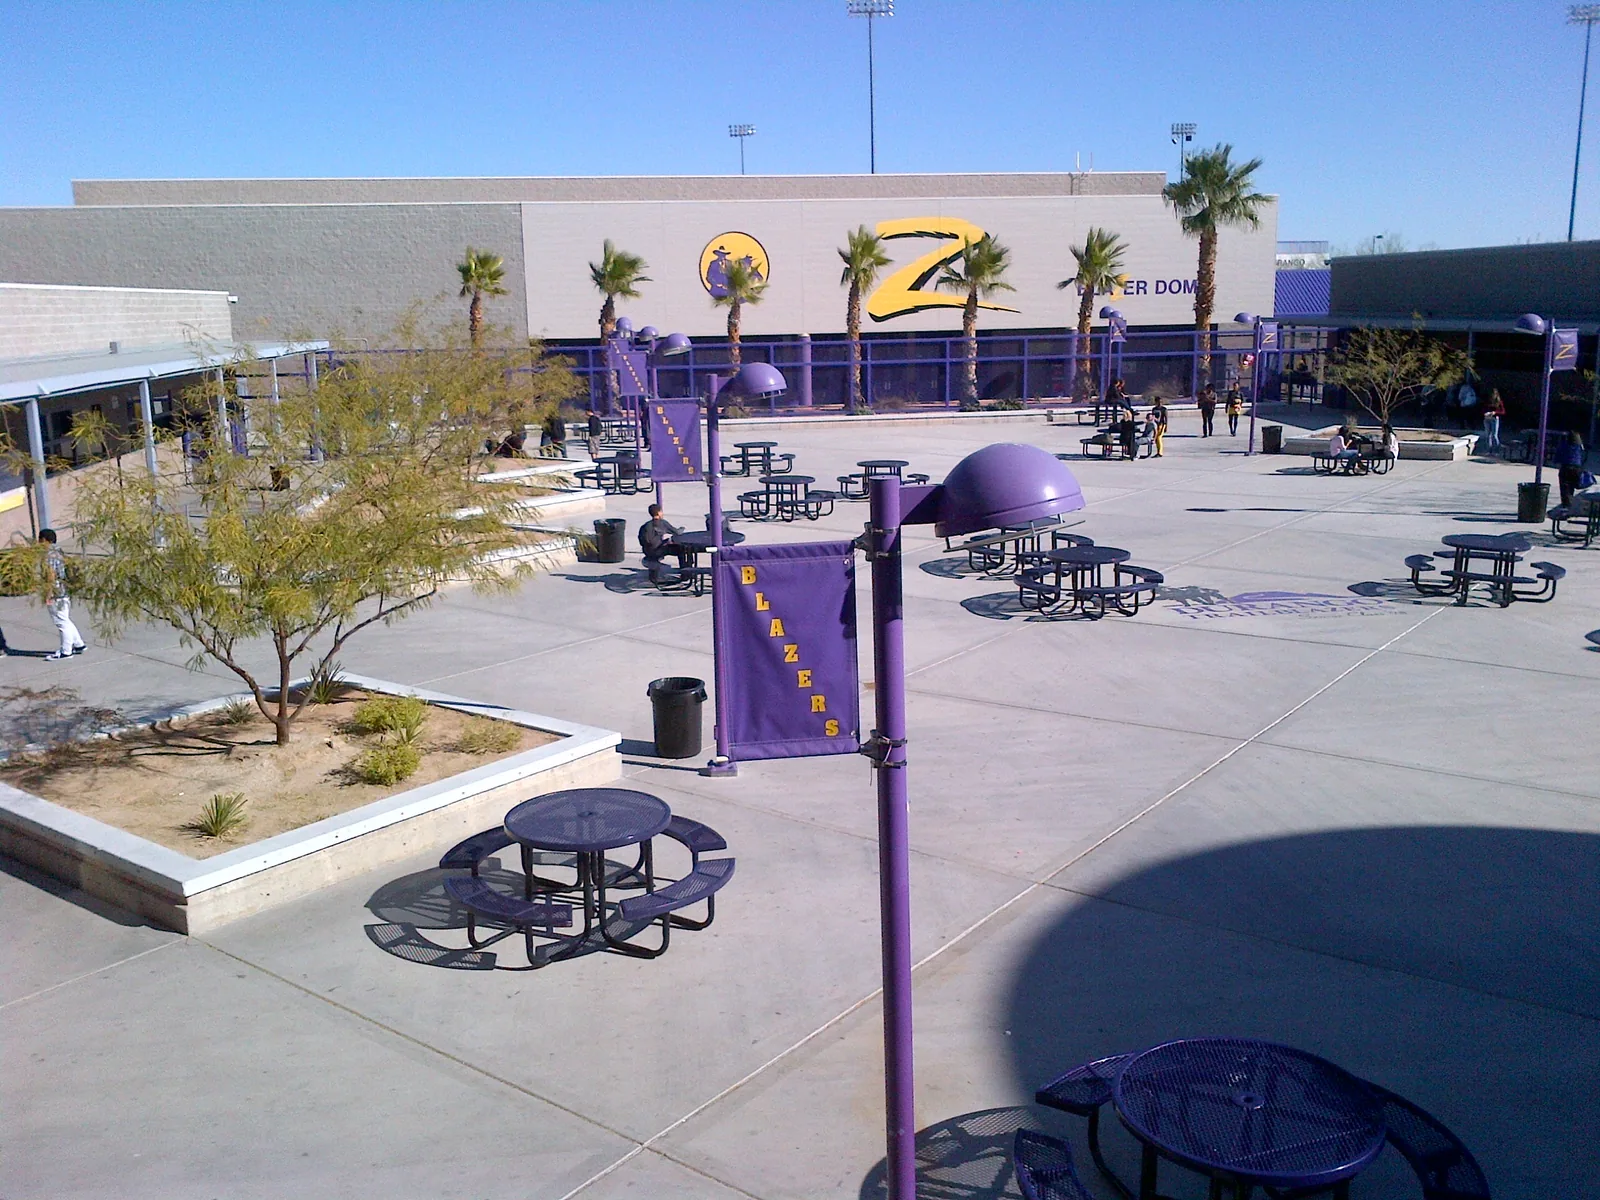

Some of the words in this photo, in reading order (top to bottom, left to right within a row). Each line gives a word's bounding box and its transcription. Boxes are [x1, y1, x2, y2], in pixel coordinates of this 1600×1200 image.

[1155, 279, 1198, 295] DOM
[1555, 343, 1576, 360] Z
[656, 405, 695, 475] BLAZERS
[1171, 599, 1384, 614] DURANGO
[740, 565, 840, 737] BLAZERS
